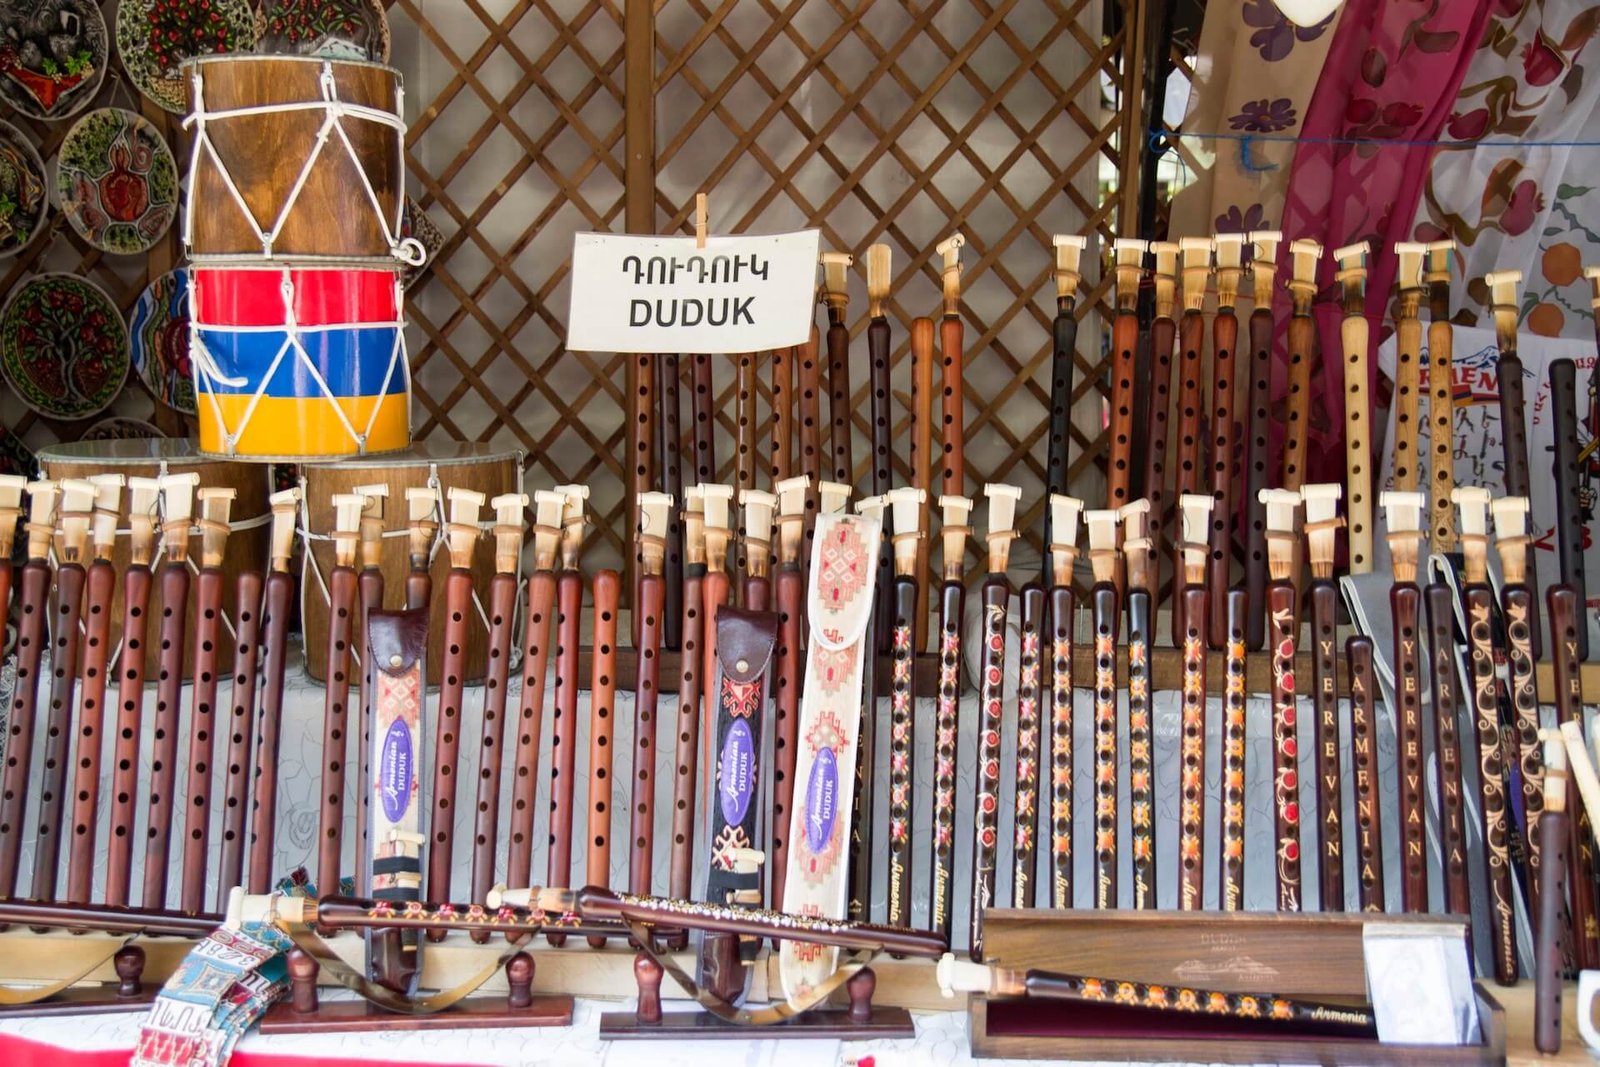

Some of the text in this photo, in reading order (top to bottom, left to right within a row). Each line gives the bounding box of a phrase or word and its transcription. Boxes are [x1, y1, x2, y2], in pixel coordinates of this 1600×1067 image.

[622, 254, 769, 285] ԴՈՒԴՈՒԿ
[629, 296, 756, 328] DUDUK
[386, 740, 398, 811] Armenian
[397, 751, 407, 792] DUDUK
[727, 740, 739, 812] Armenian
[738, 752, 748, 793] DUDUK
[1320, 641, 1340, 857] YEREVAN
[1351, 680, 1375, 880] ARMENIA
[1402, 641, 1422, 856] YEREVAN
[1437, 647, 1462, 864] ARMENIA
[811, 767, 824, 841] Armenian
[823, 779, 834, 821] DUDUK
[889, 857, 904, 922] Armenia
[935, 861, 950, 925] Armenia
[1493, 879, 1516, 976] Armenia
[1311, 1006, 1368, 1024] Armenia
